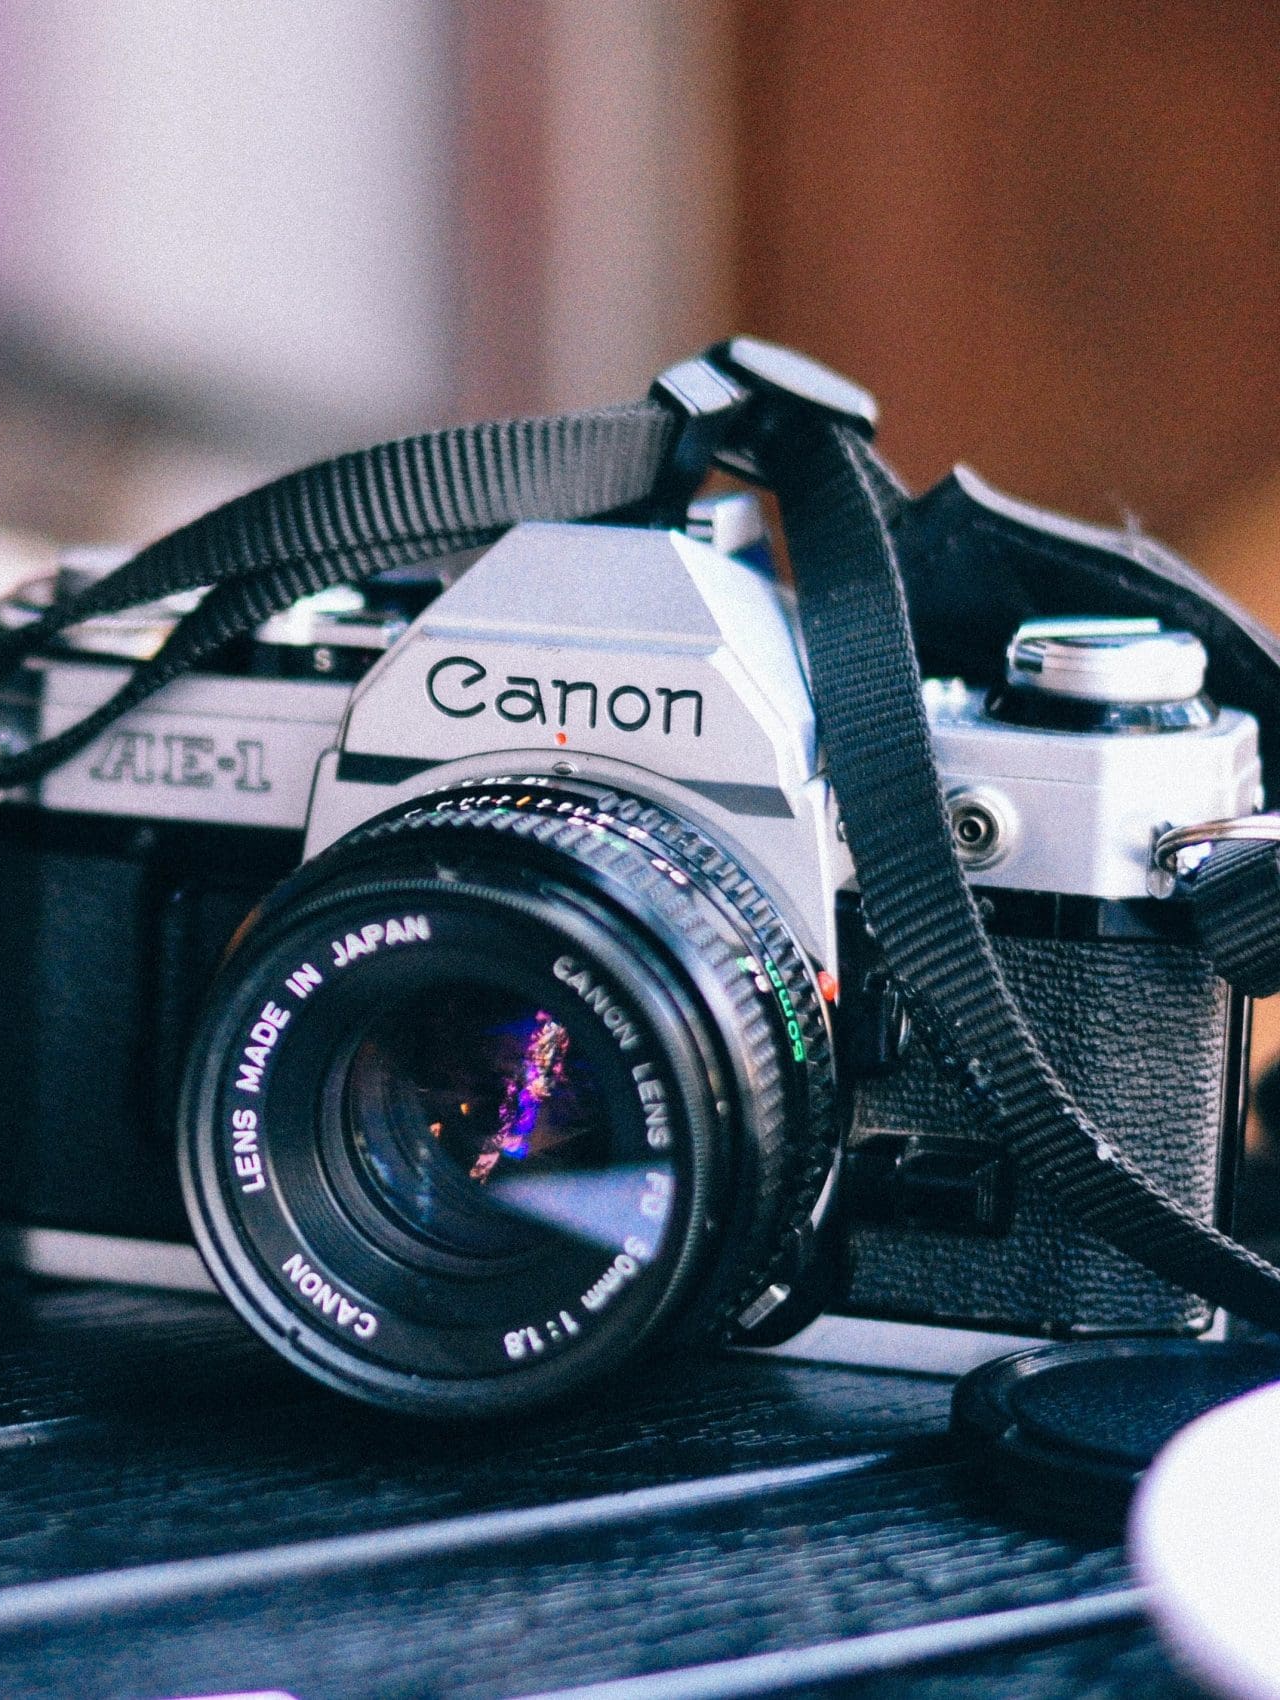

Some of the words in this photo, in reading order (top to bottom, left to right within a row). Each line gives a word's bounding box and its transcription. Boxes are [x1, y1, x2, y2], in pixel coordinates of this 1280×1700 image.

[425, 655, 704, 737] Canon
[90, 730, 271, 792] AE-1
[285, 962, 324, 1000] IN
[331, 915, 431, 967] JAPAN
[235, 1000, 291, 1092] MADE
[552, 954, 640, 1052] CANON
[631, 1061, 672, 1151] LENS
[231, 1108, 267, 1194] LENS
[282, 1254, 379, 1338] CANON
